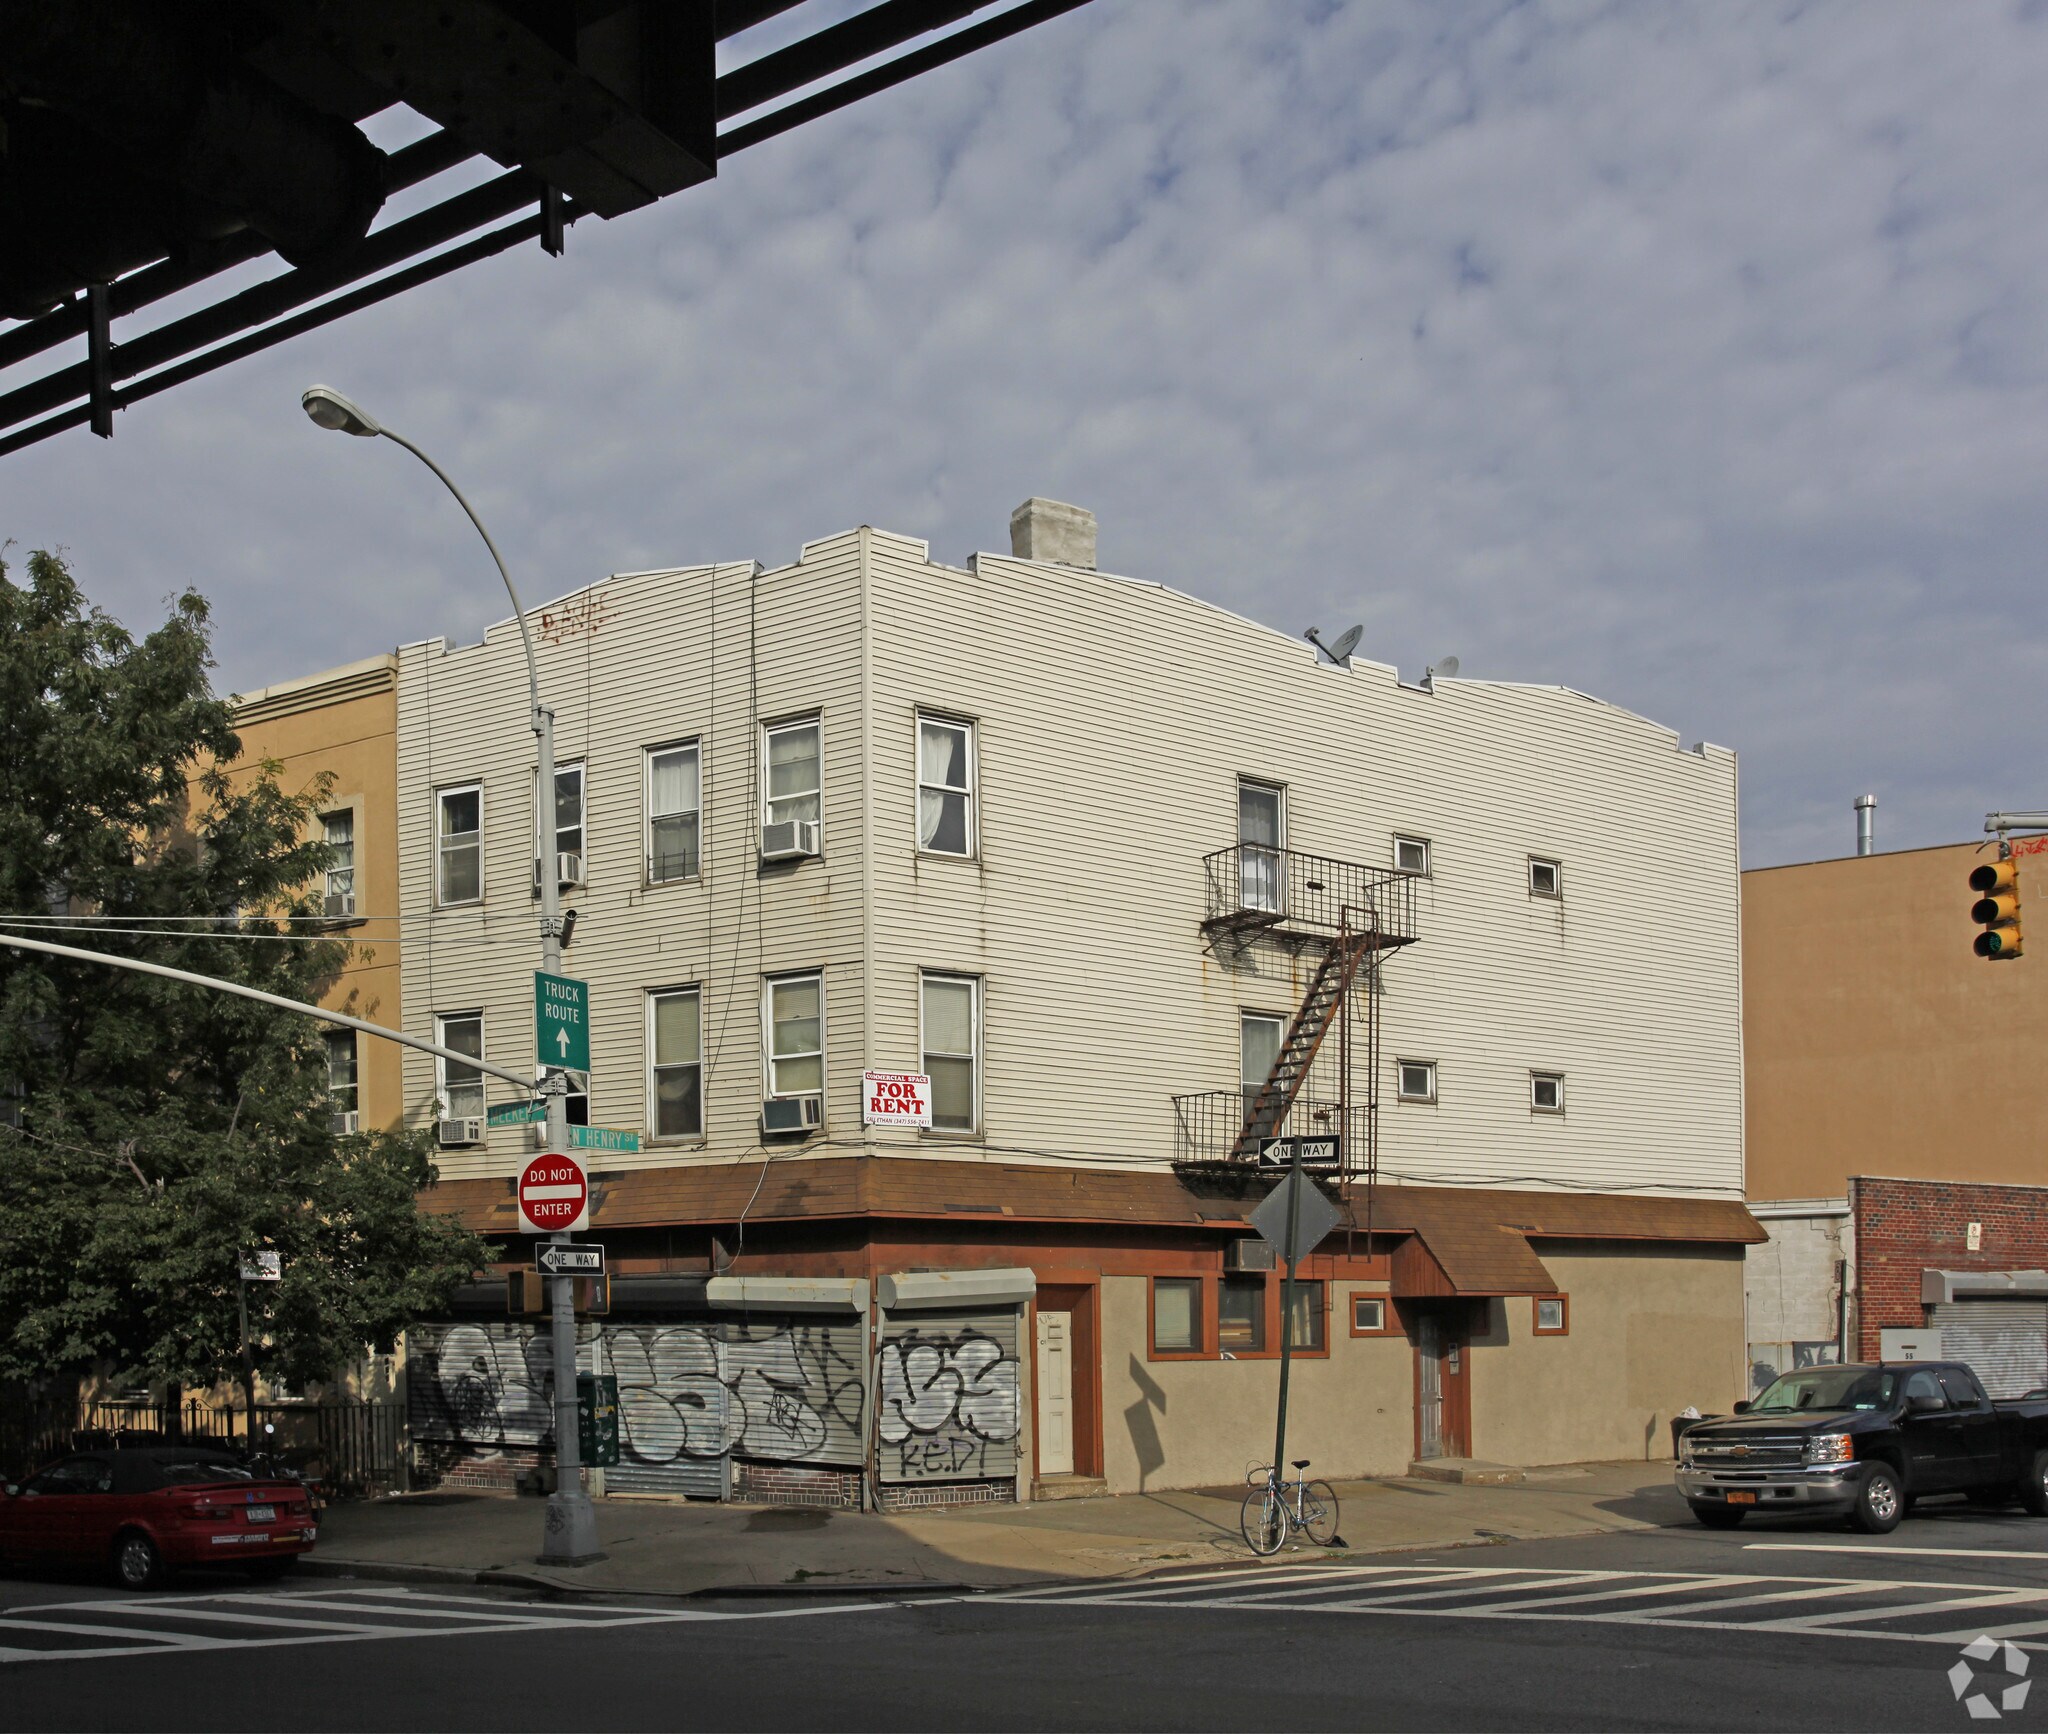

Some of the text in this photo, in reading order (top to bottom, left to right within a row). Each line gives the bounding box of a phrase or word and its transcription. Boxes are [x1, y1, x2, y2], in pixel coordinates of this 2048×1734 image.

[544, 981, 580, 1003] TRUCK
[545, 1002, 580, 1024] ROUTE
[866, 1073, 905, 1082] COMMERCIAL
[876, 1082, 917, 1099] FOR
[870, 1097, 925, 1115] RENT
[572, 1128, 634, 1149] N HENRY ST
[1273, 1144, 1329, 1158] ONE WAY
[530, 1168, 574, 1182] DO NOT
[534, 1203, 572, 1216] ENTER
[547, 1253, 596, 1266] ONE WAY
